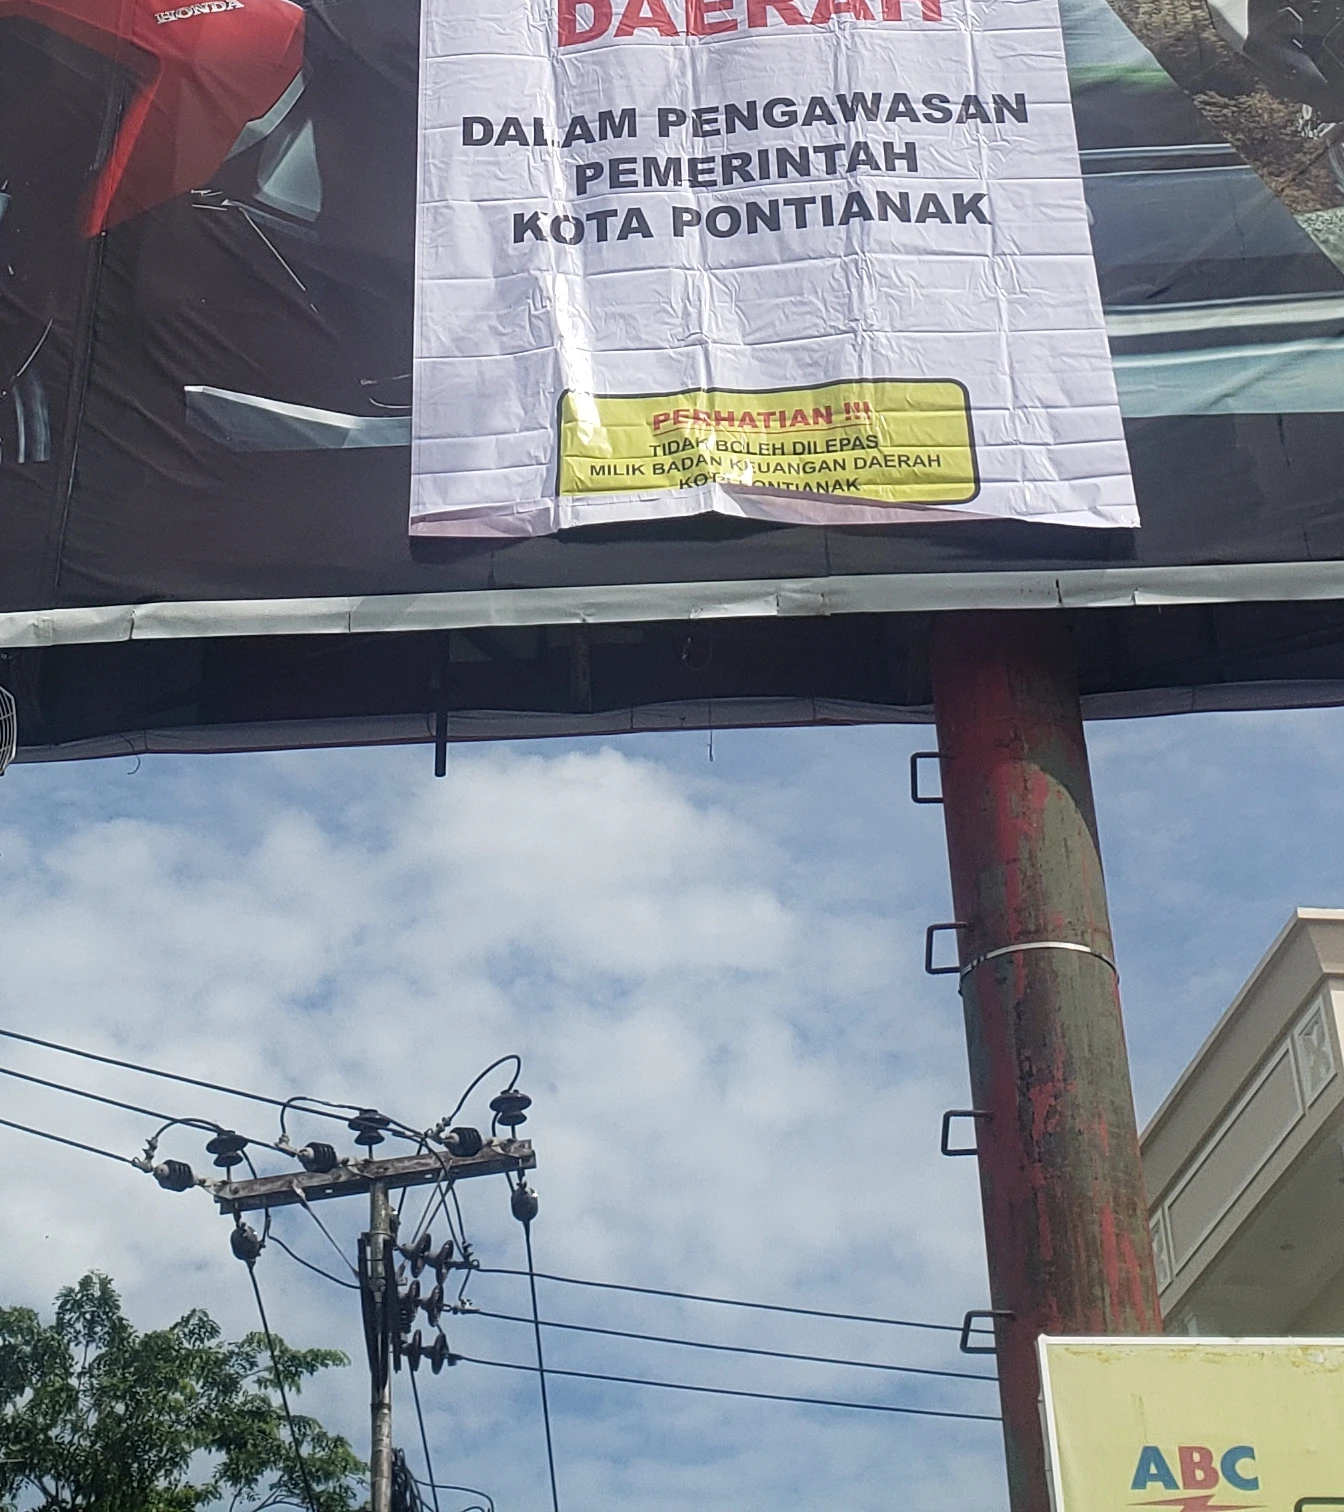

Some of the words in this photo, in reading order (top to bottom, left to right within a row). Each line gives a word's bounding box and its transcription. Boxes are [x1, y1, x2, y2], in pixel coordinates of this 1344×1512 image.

[155, 0, 245, 25] HONDA
[461, 106, 639, 148] DALAM
[658, 92, 1029, 139] PENGAWASAN
[575, 141, 920, 196] PEMERINTAH
[513, 208, 655, 246] KOTA
[673, 191, 992, 238] PONTIANAK
[652, 405, 834, 431] PERHATIAN
[842, 400, 873, 422] !!!
[590, 462, 645, 477] MILIK
[652, 453, 722, 476] BADAN
[855, 452, 942, 471] DAERAH
[649, 436, 707, 457] TIDAK
[716, 439, 785, 456] BOLEH
[792, 434, 879, 455] DILEPAS
[1130, 1445, 1261, 1491] ABC
